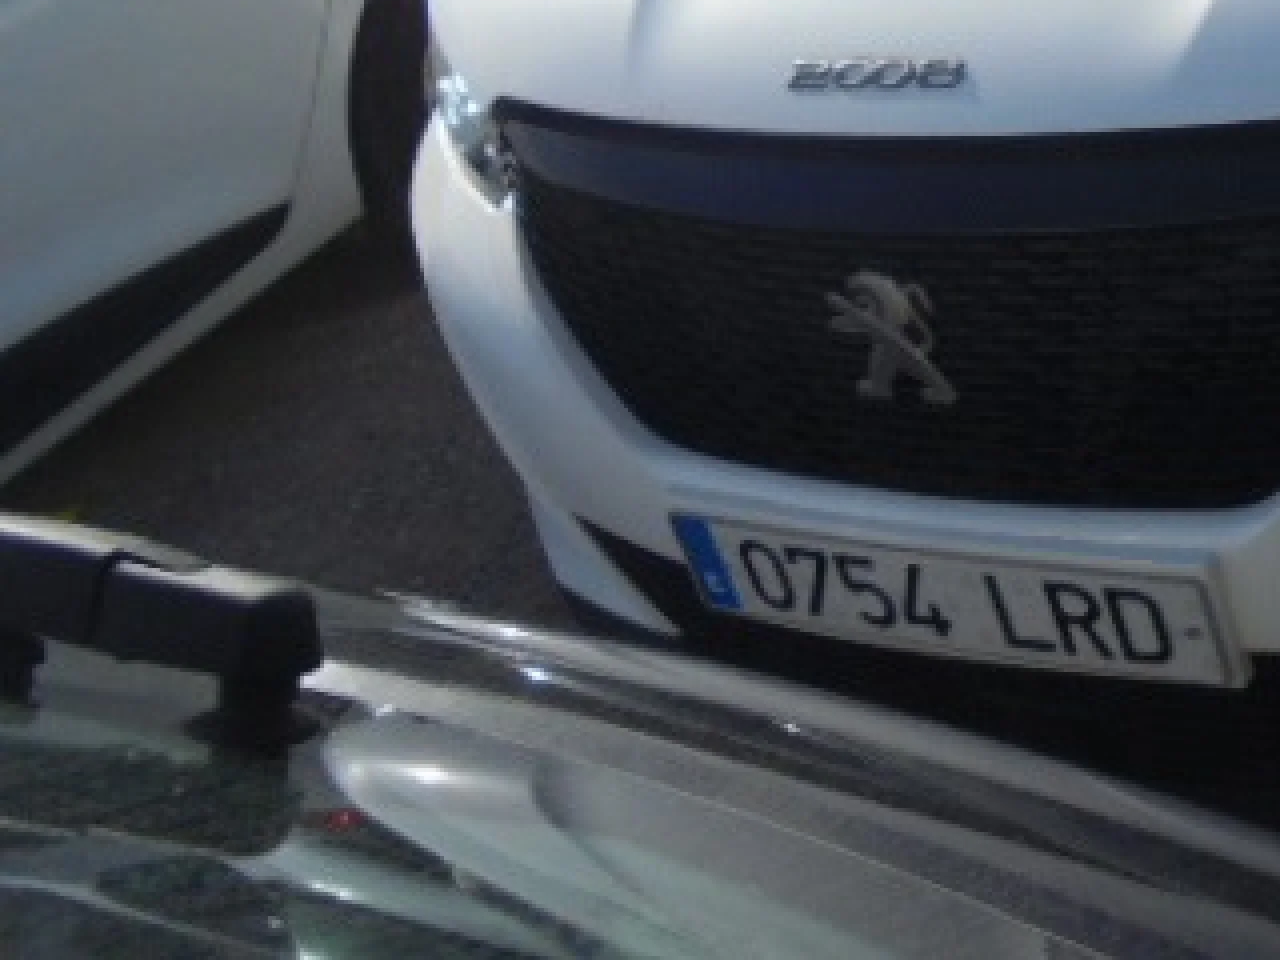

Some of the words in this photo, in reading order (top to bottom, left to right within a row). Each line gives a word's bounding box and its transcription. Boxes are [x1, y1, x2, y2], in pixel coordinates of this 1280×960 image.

[788, 58, 968, 93] 2008
[739, 539, 952, 637] 0754
[984, 574, 1172, 663] LRD
